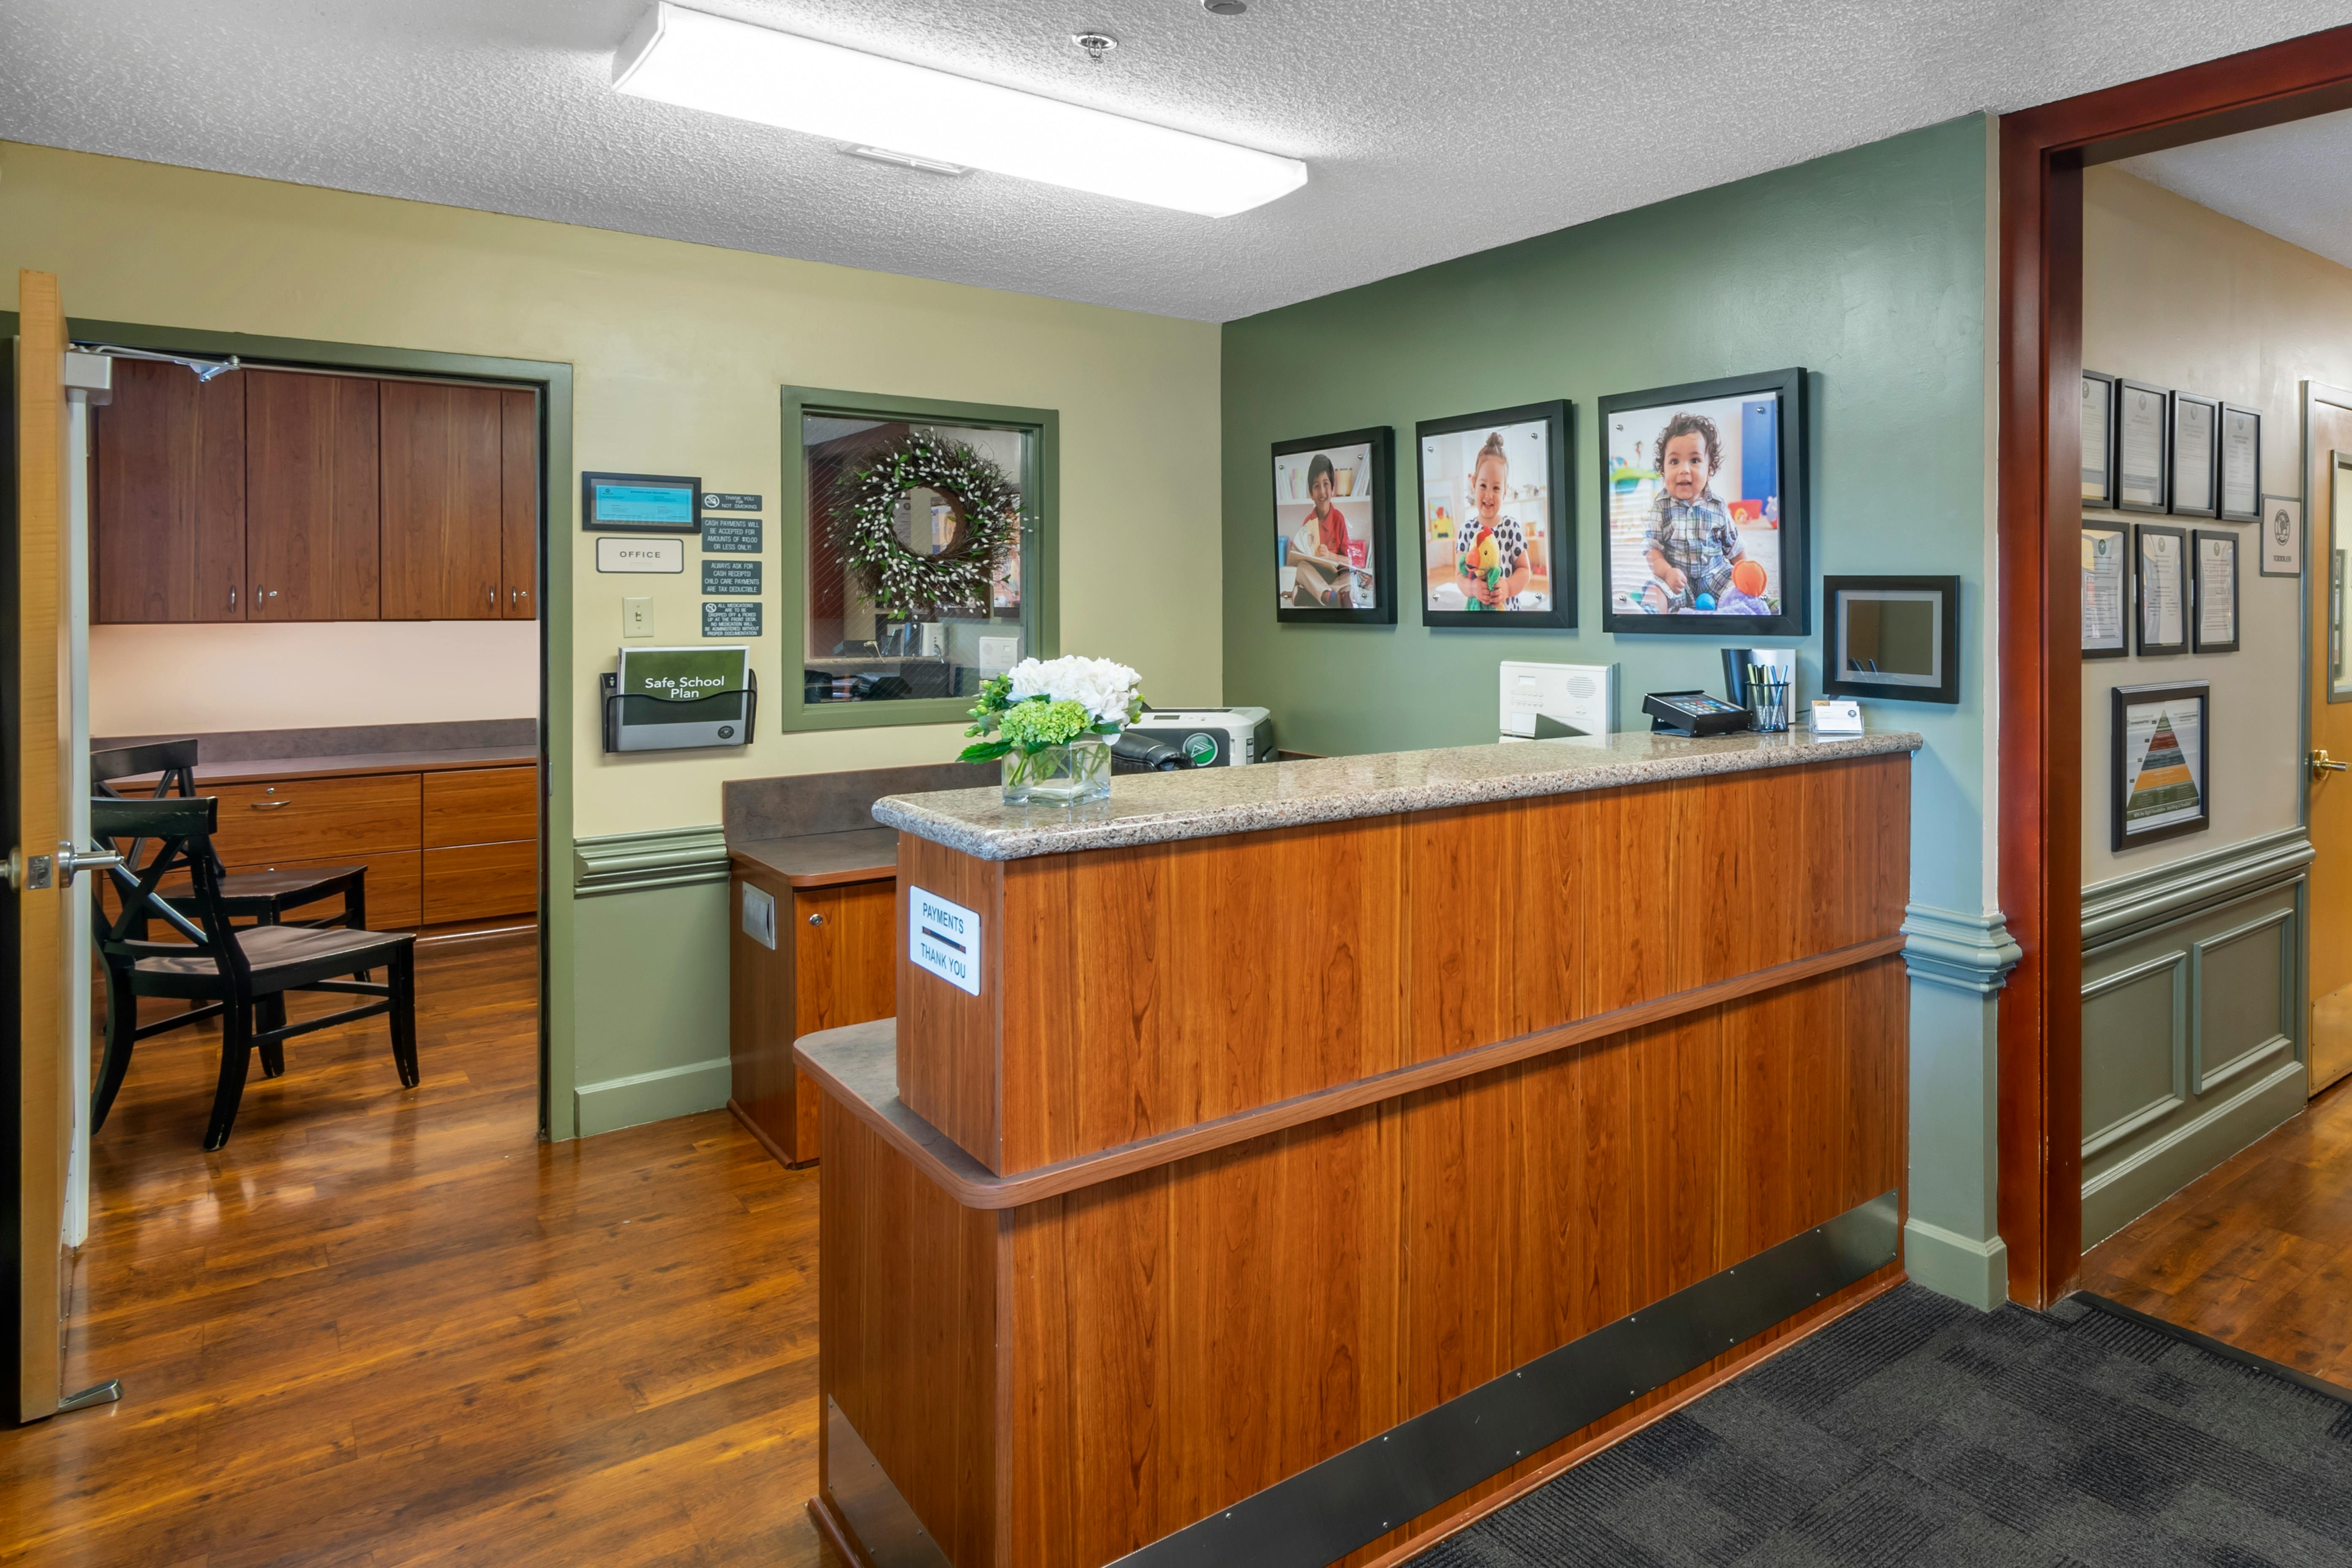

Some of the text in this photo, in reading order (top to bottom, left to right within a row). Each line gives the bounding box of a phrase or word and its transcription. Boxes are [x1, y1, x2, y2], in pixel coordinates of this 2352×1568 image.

[645, 675, 724, 688] Safe School
[671, 689, 699, 698] Plan
[923, 902, 964, 934] PAYMENTS
[921, 942, 966, 979] THANK YOU
